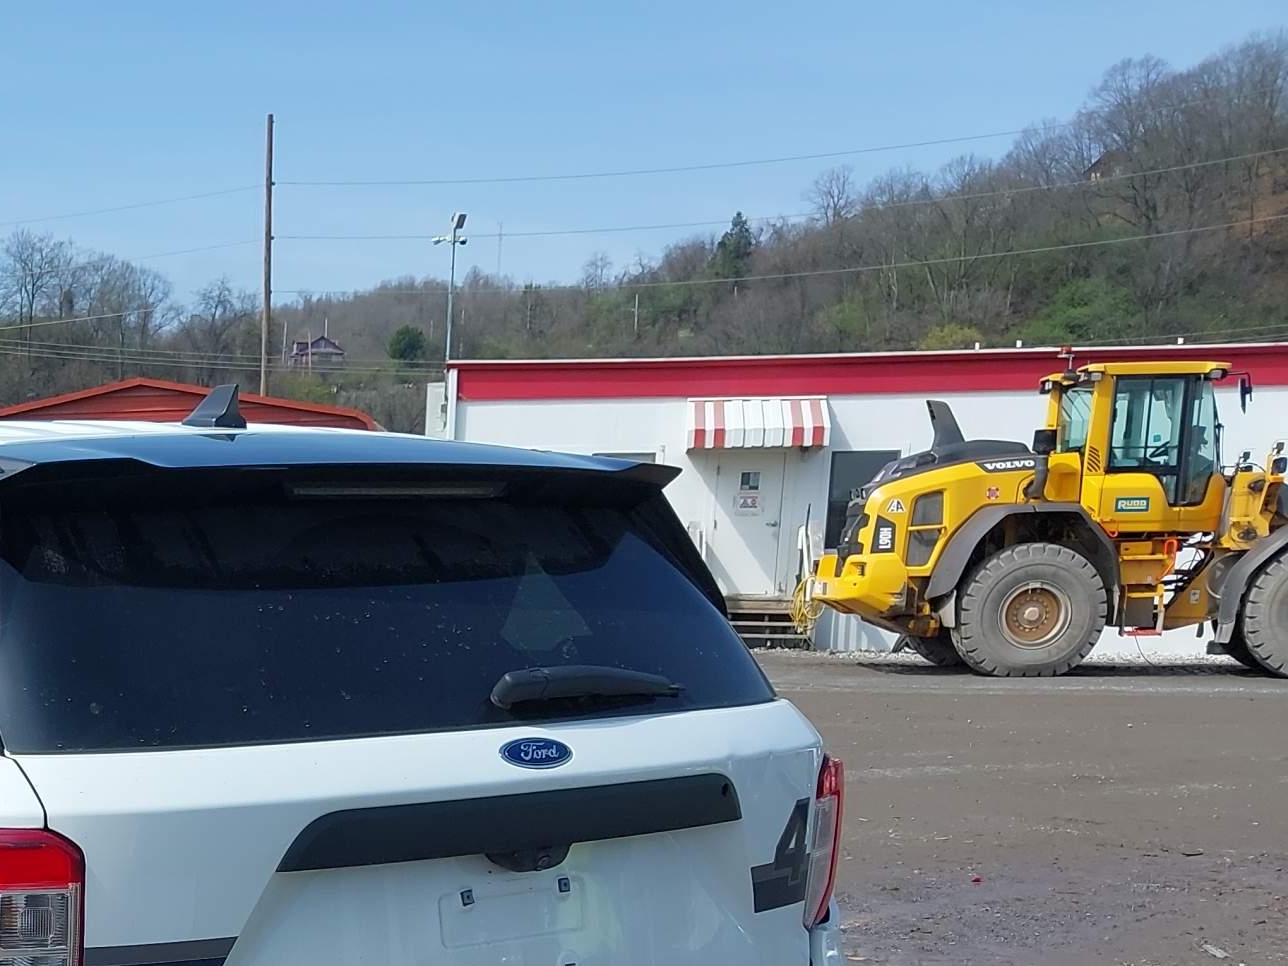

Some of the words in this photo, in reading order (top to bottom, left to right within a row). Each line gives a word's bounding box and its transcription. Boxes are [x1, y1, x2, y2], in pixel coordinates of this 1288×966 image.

[983, 459, 1035, 470] VOLVO
[520, 742, 560, 761] Ford
[774, 797, 811, 886] 4
